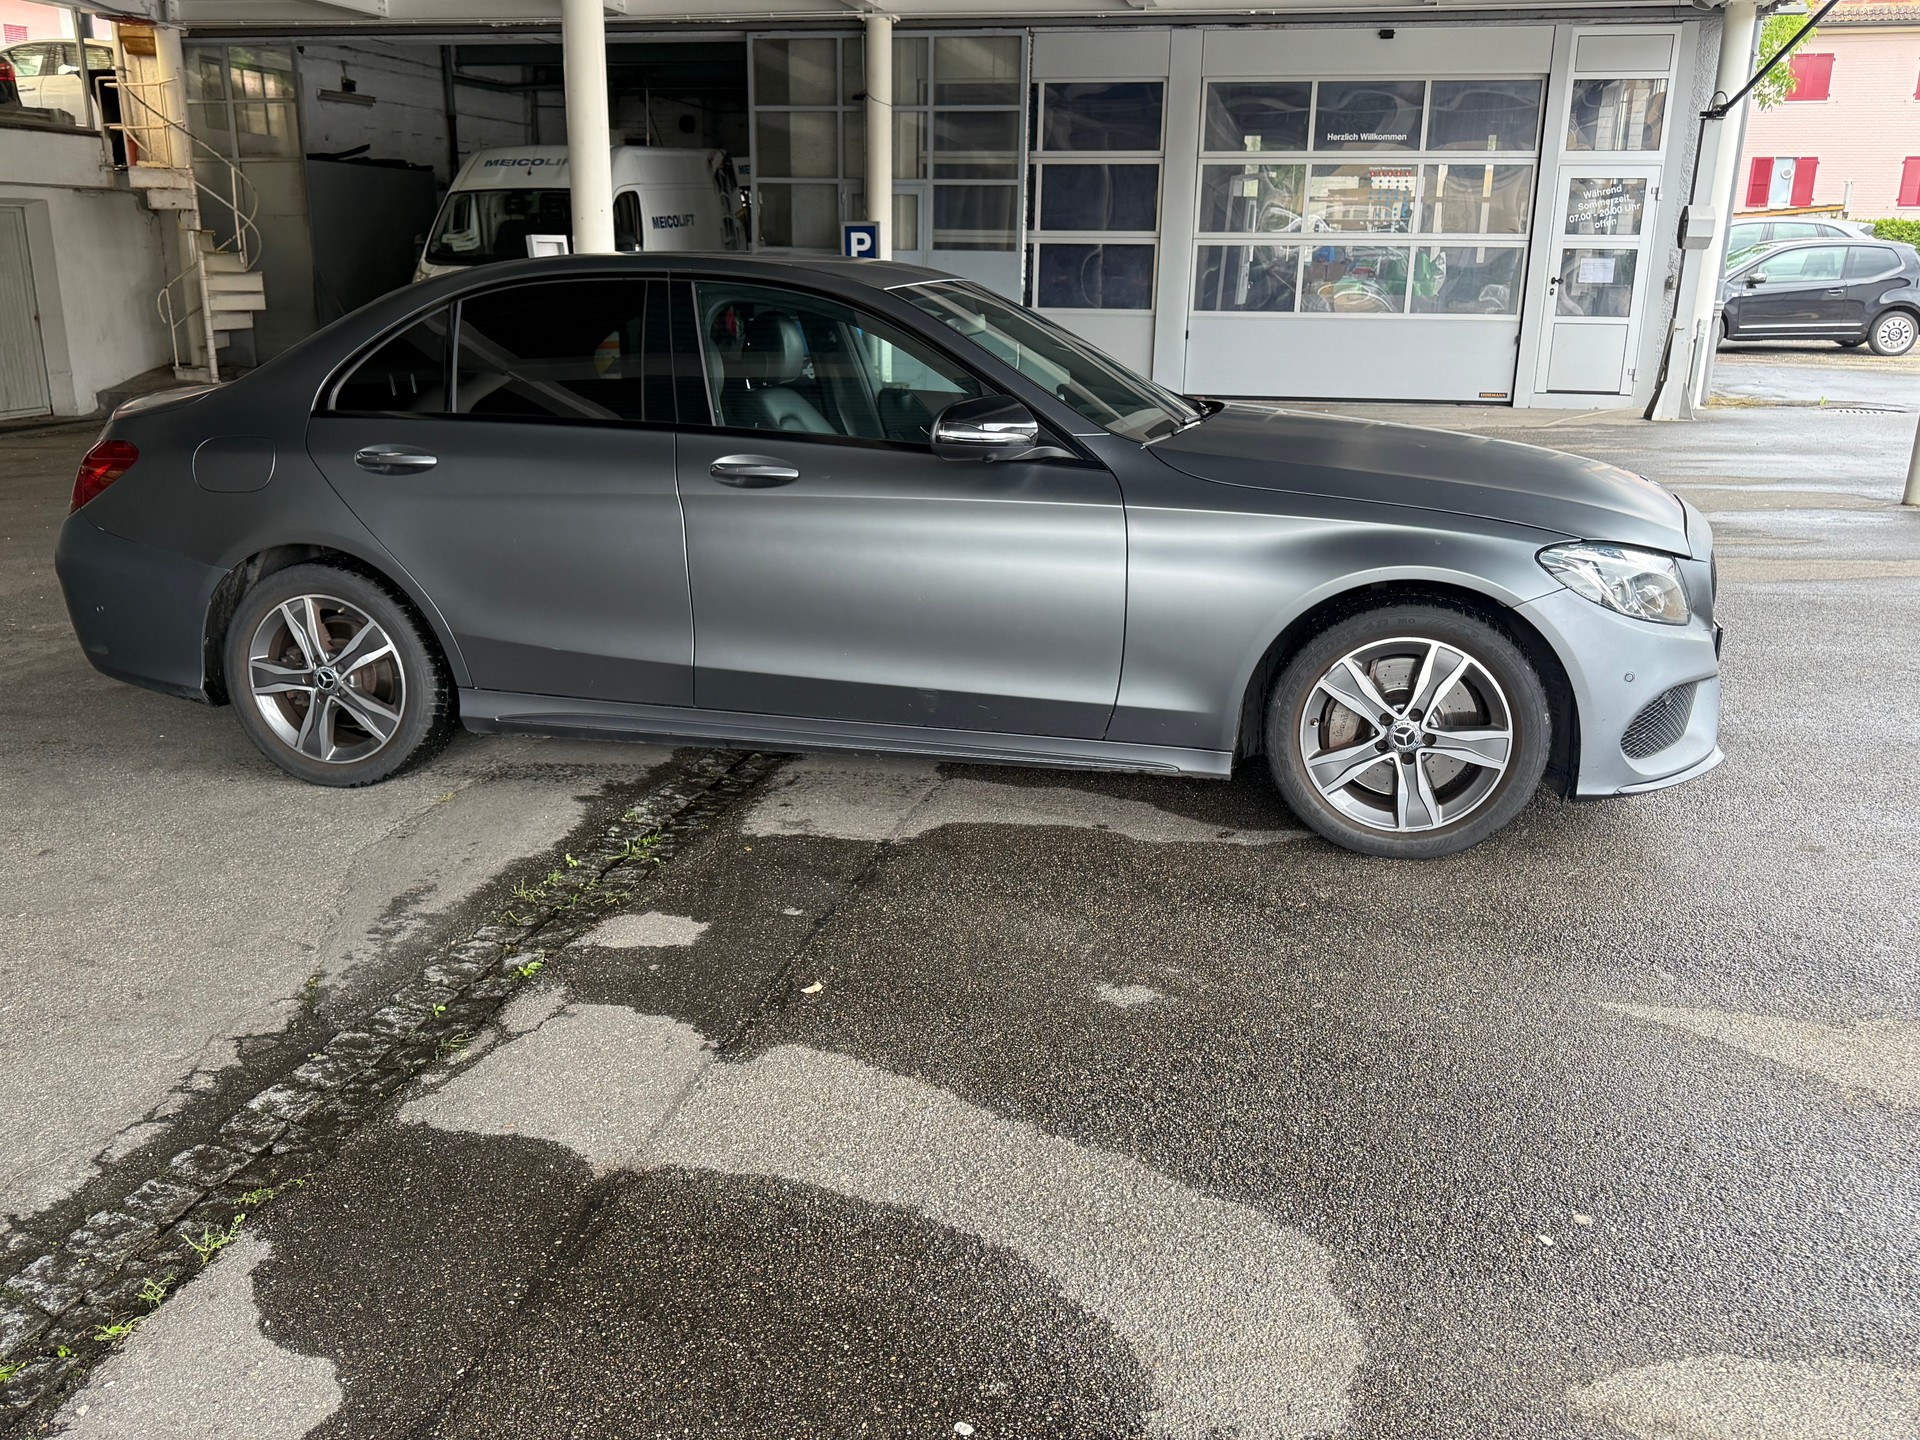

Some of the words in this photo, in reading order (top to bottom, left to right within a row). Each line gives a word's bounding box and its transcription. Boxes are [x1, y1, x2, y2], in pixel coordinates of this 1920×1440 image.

[1327, 133, 1358, 141] Herzlich
[1360, 133, 1407, 141] Willkommen
[484, 157, 569, 168] MEICOLIF
[1583, 185, 1622, 199] Während
[1578, 195, 1630, 211] Sommerzeit
[1569, 212, 1591, 223] 07.00
[1599, 206, 1622, 218] 20.00
[1625, 203, 1640, 212] Uhr
[651, 214, 695, 230] MEICOLIFT
[1594, 218, 1617, 229] offen
[851, 232, 871, 257] P
